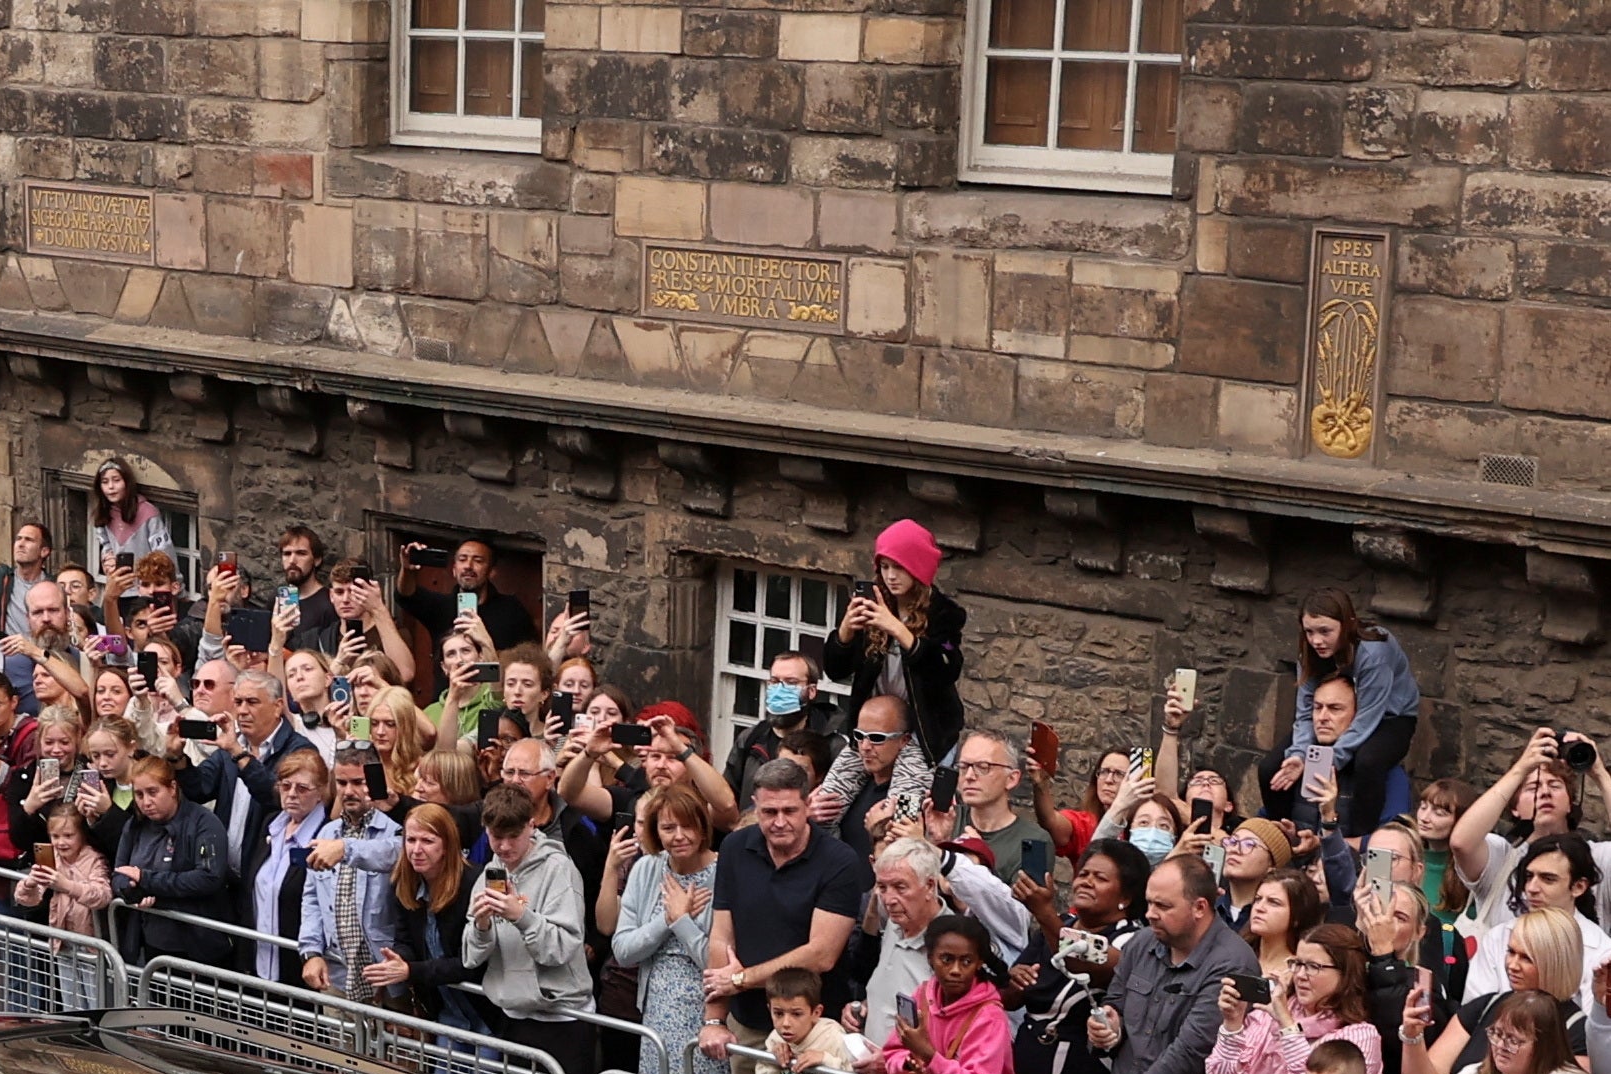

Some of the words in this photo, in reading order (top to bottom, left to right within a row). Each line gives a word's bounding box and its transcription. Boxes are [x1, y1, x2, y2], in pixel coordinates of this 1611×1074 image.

[1332, 240, 1373, 257] SPES
[1321, 260, 1381, 278] ALTERA
[657, 271, 694, 292] RES
[708, 294, 779, 320] VMBRA
